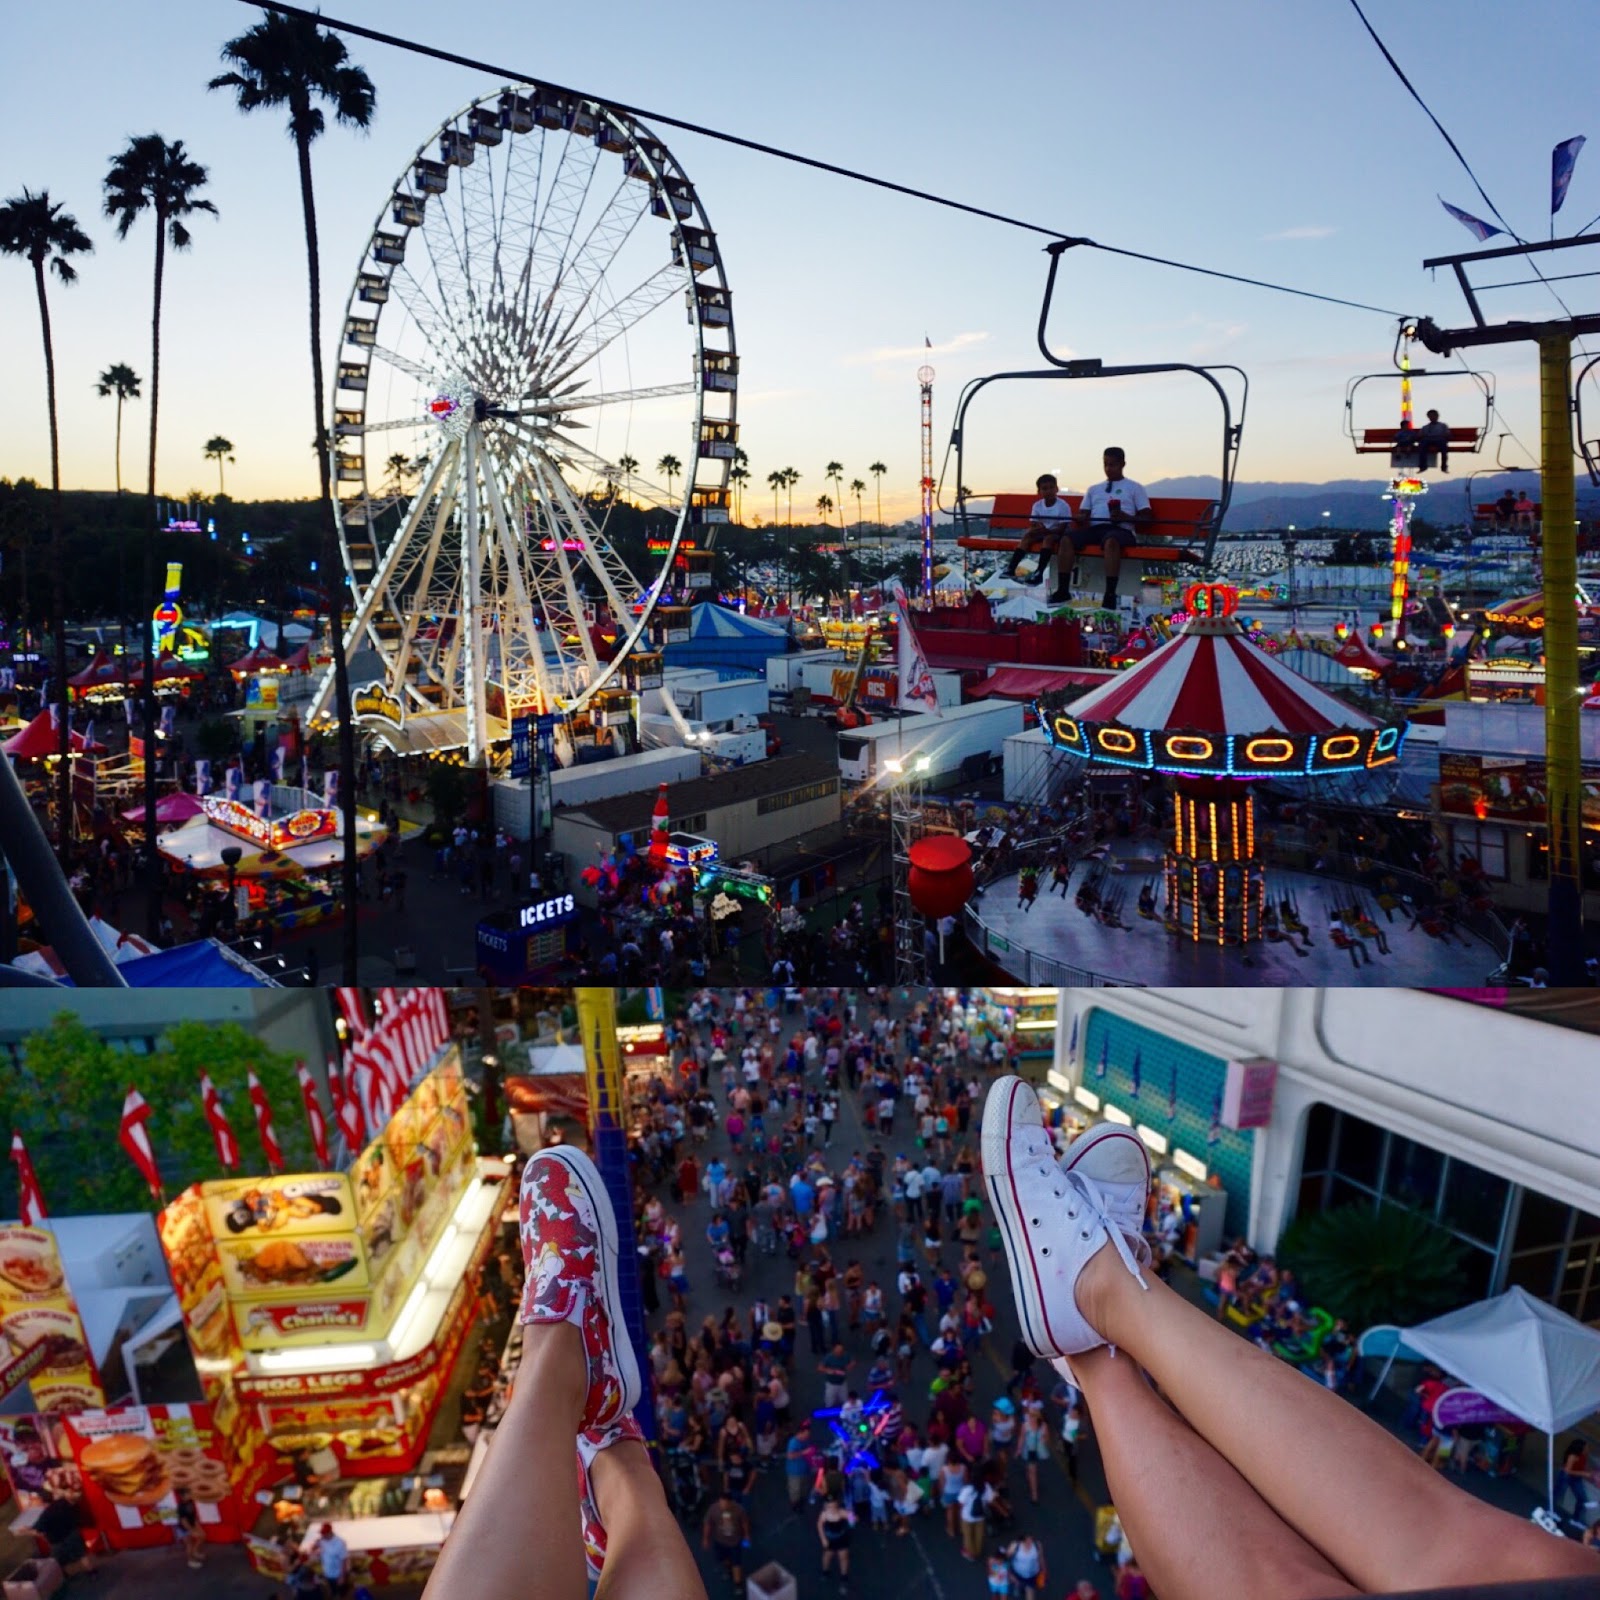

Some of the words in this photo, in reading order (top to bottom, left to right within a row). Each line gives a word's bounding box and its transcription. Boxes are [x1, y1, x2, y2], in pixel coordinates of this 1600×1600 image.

[867, 681, 886, 697] RCS
[477, 930, 508, 953] TICKETS
[281, 1313, 359, 1329] Charlie's
[239, 1377, 301, 1392] FROG
[306, 1373, 364, 1387] LEGS
